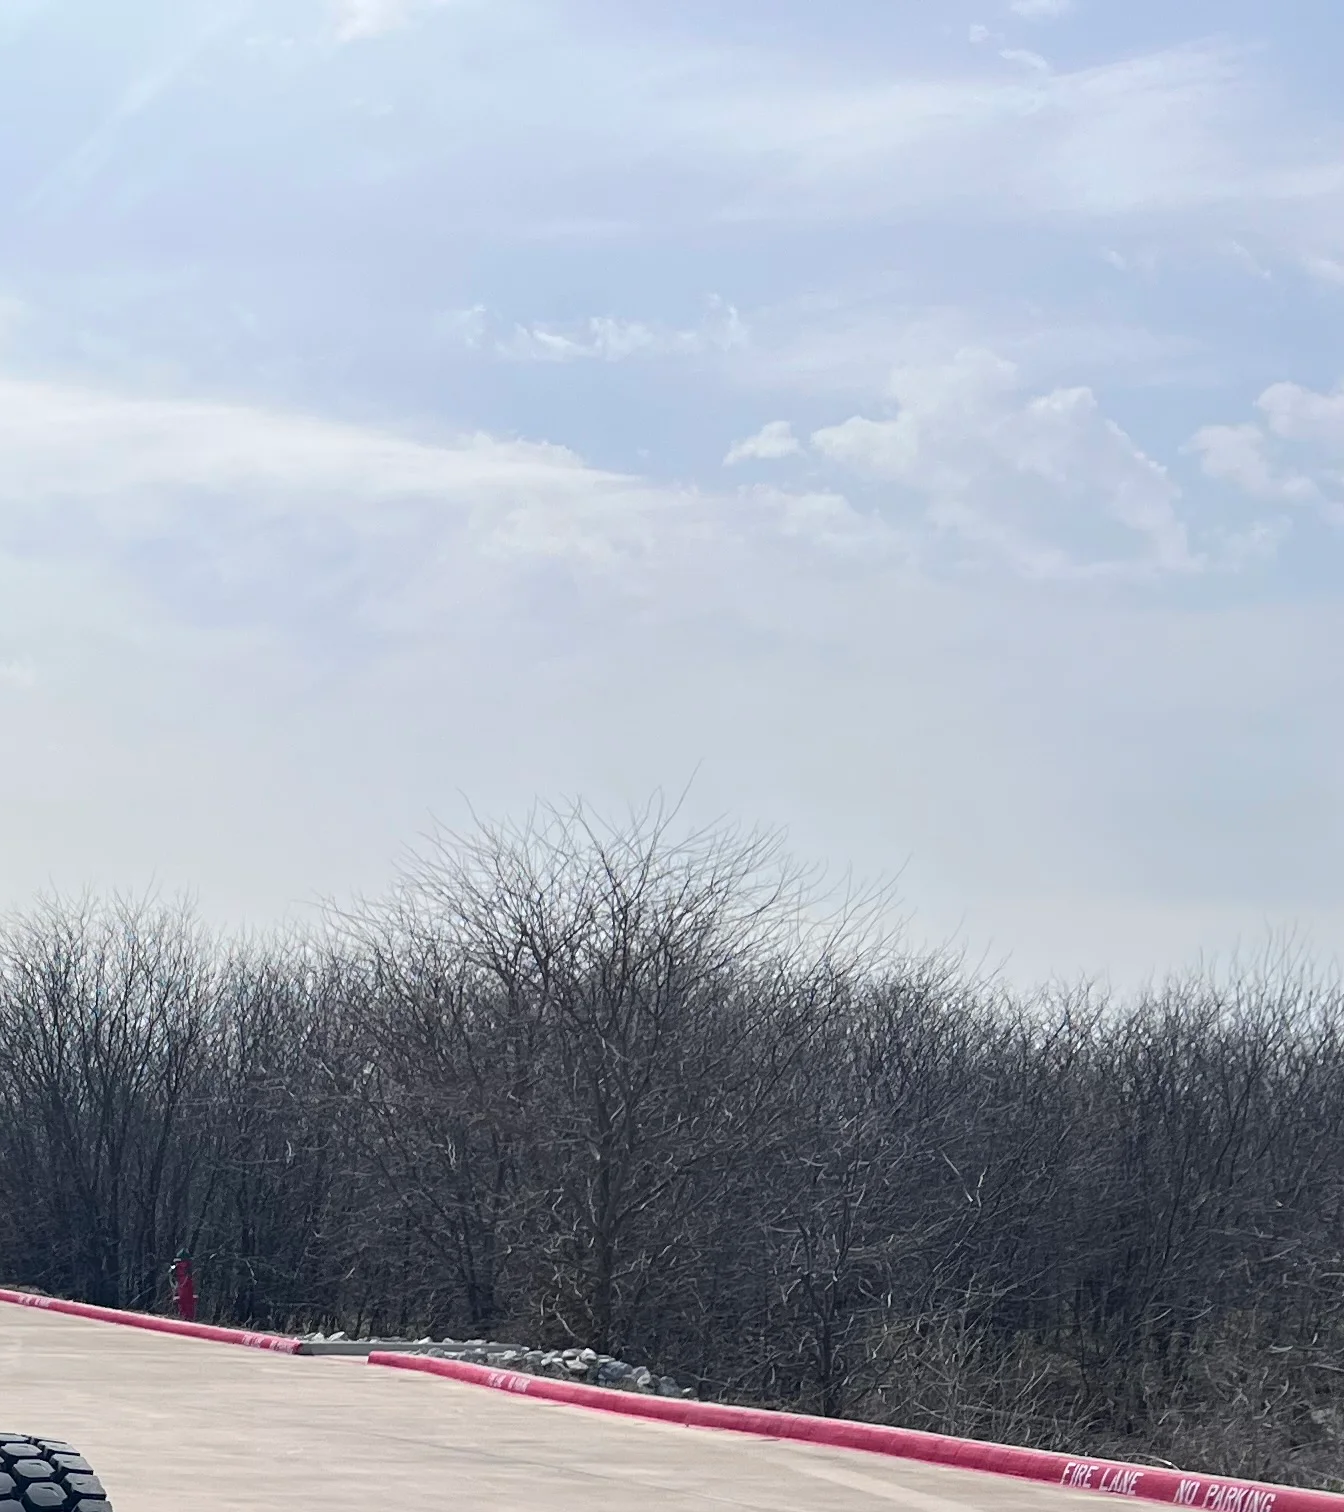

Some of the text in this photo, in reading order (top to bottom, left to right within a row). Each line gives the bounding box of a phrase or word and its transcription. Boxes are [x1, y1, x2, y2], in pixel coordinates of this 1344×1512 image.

[1059, 1461, 1100, 1489] FIRE
[1098, 1467, 1145, 1496] LANE
[1172, 1479, 1201, 1505] NO
